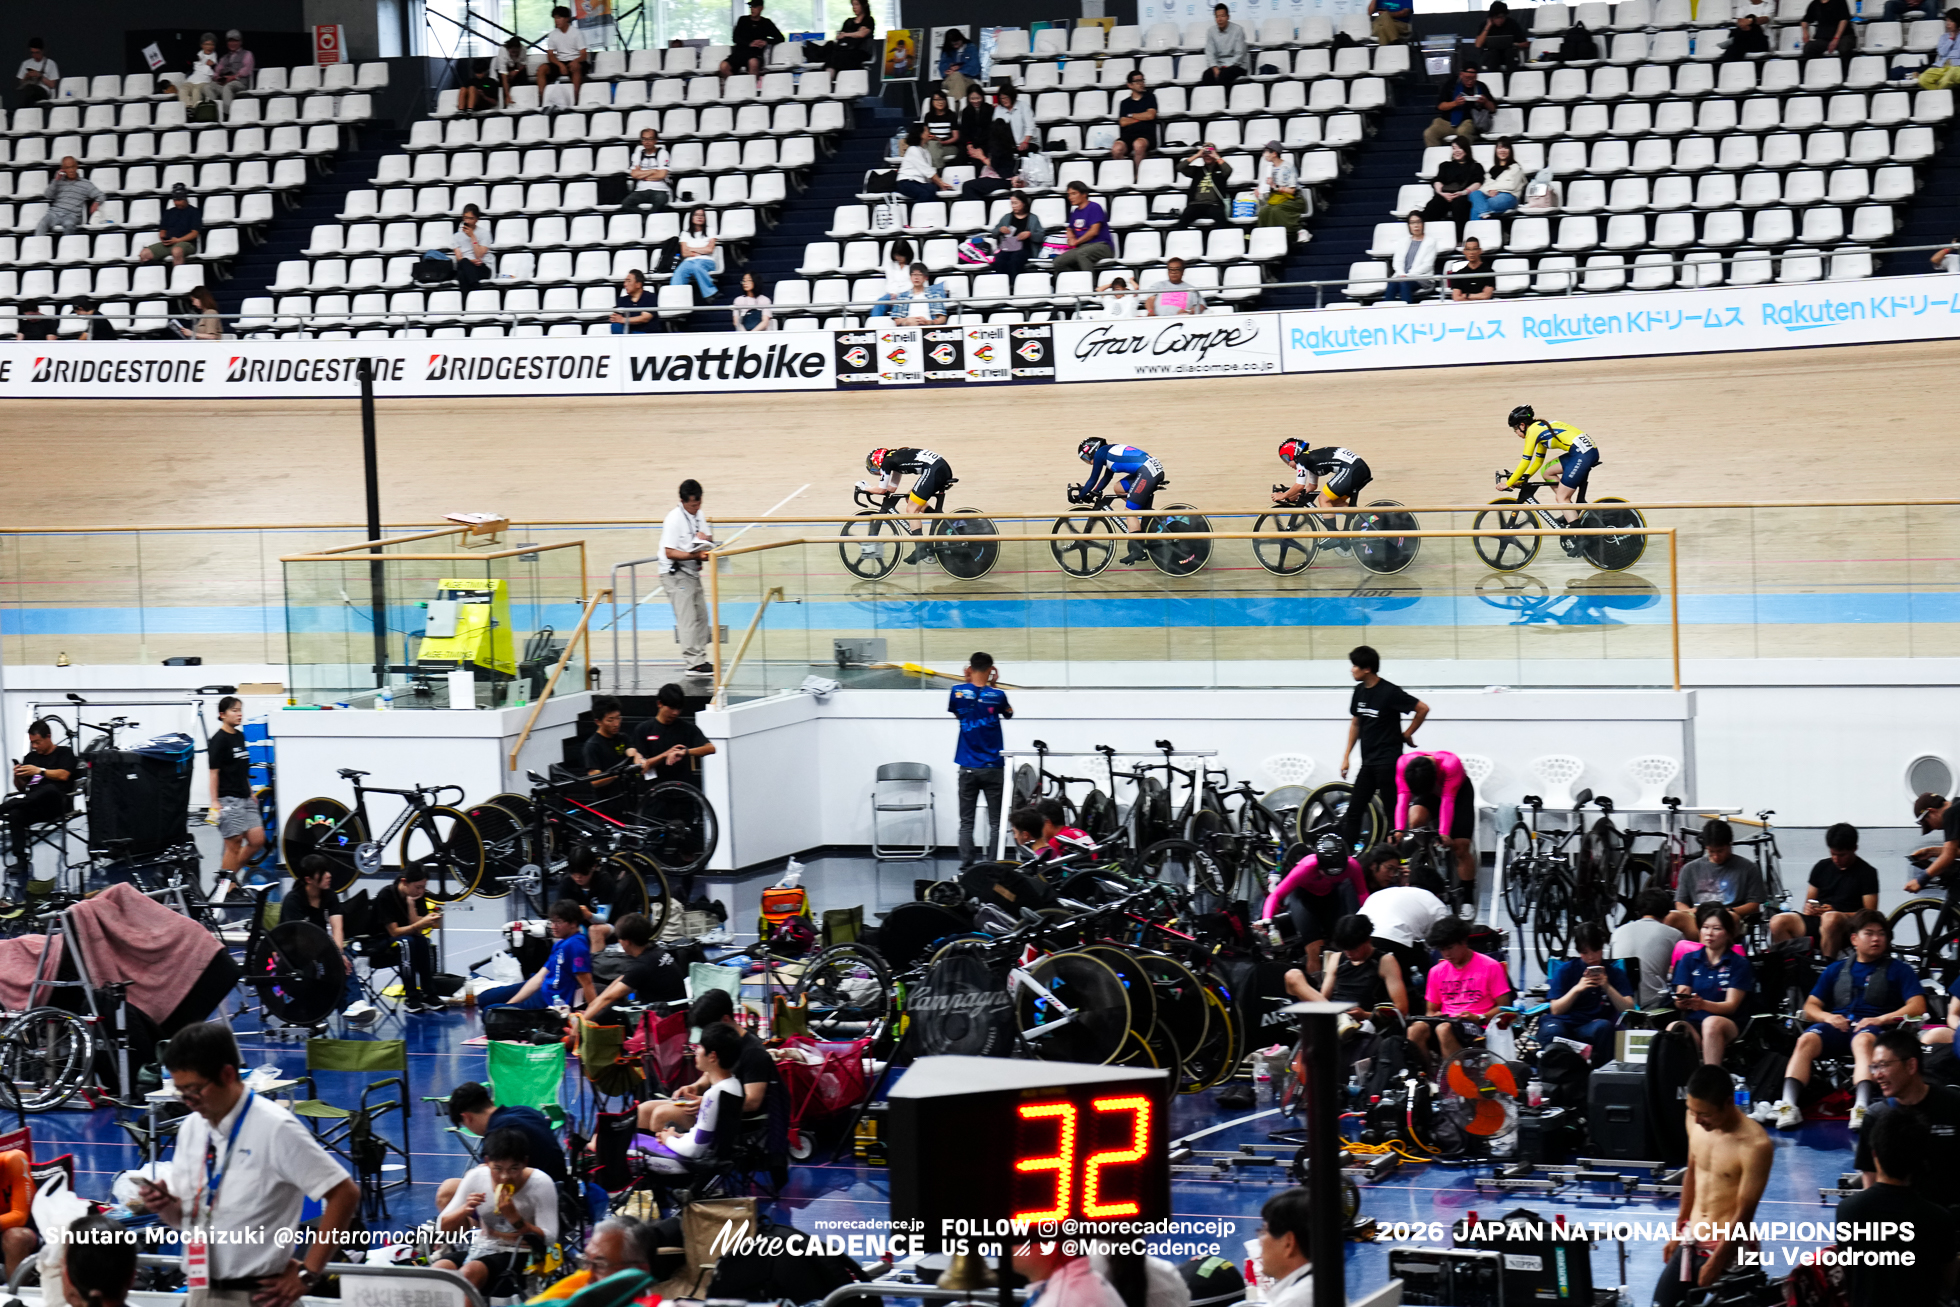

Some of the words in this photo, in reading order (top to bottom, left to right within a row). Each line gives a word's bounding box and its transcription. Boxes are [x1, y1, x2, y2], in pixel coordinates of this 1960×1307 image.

[1522, 313, 1623, 338] Rakuten
[1627, 306, 1745, 332] Kドリームス
[1762, 299, 1866, 325] Rakuten
[1870, 293, 1960, 318] Kドリー
[1075, 324, 1149, 362] Gran
[1153, 322, 1259, 362] Compe
[1291, 325, 1388, 349] Rakuten
[1392, 319, 1506, 344] Kドリームス
[31, 357, 207, 382] BRIDGESTONE
[226, 356, 406, 382] BRIDGESTNE
[426, 354, 611, 381] BRIDGESTONE
[630, 343, 826, 381] wattbike
[907, 986, 1010, 1018] Campagn
[1014, 1096, 1149, 1226] 32
